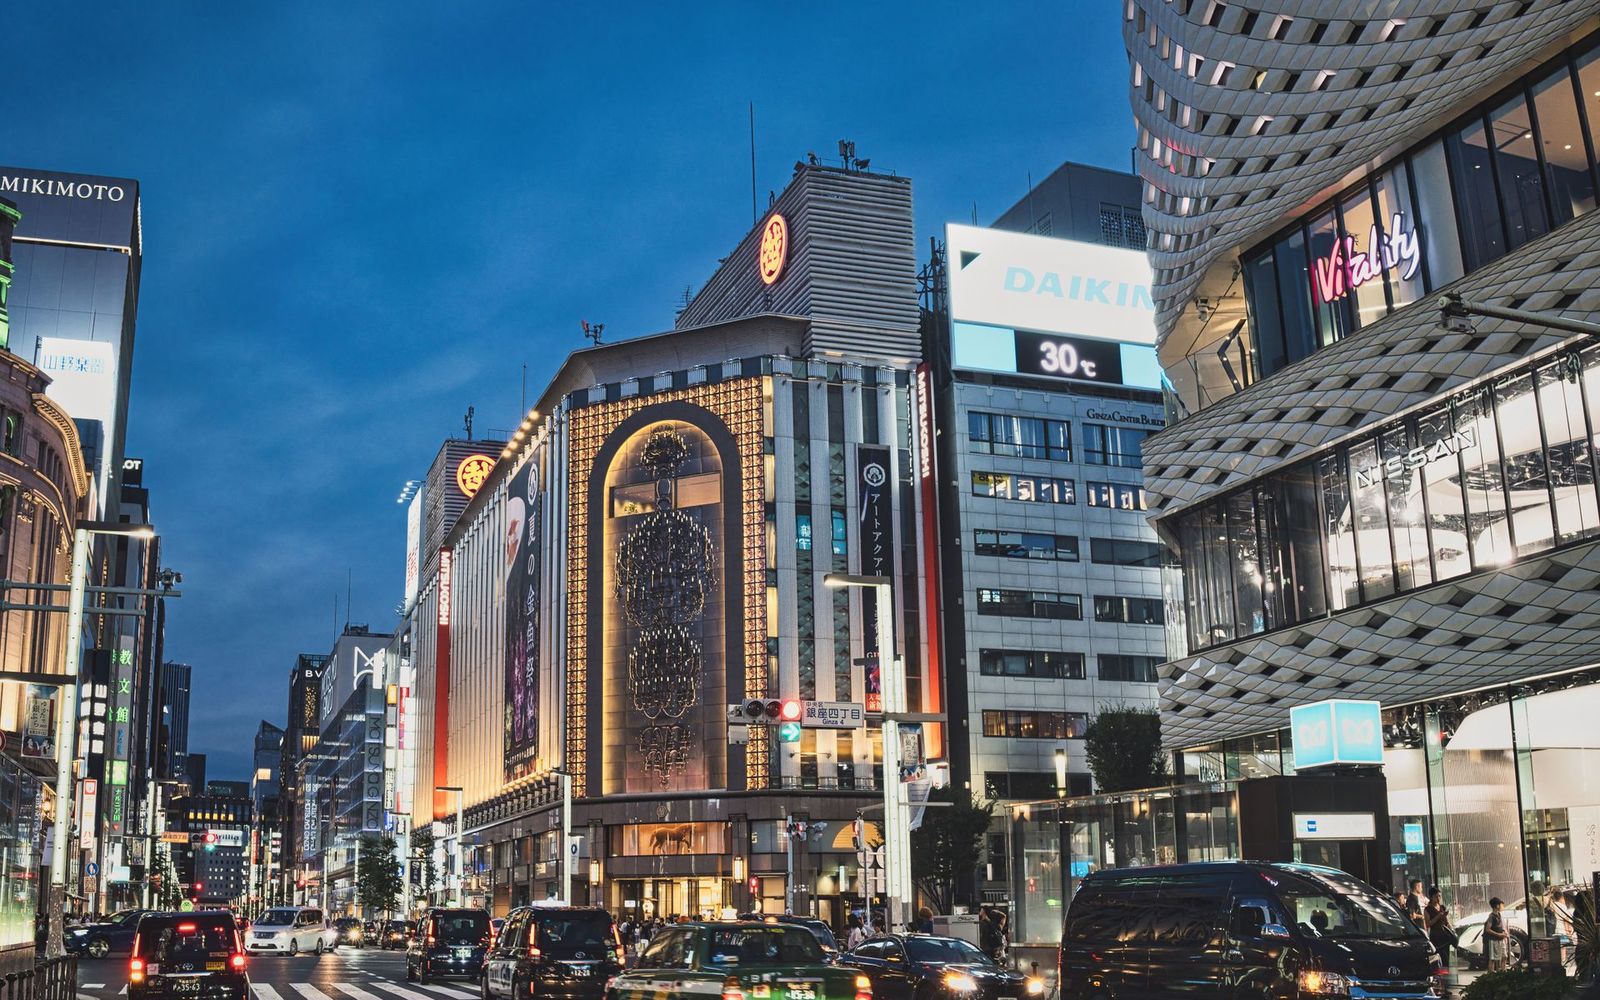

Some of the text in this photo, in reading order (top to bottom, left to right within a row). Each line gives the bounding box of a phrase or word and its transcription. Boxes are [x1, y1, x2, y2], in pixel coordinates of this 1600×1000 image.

[0, 175, 124, 202] MIKIMOTO
[1003, 266, 1154, 310] DAIKIN
[1314, 211, 1420, 304] Vitality
[918, 371, 930, 478] MITSUKOSHI
[1355, 425, 1478, 491] NISSAN
[438, 551, 450, 625] MITSUKOSHI
[116, 648, 132, 723] 教文館
[806, 708, 860, 720] 銀座四丁目
